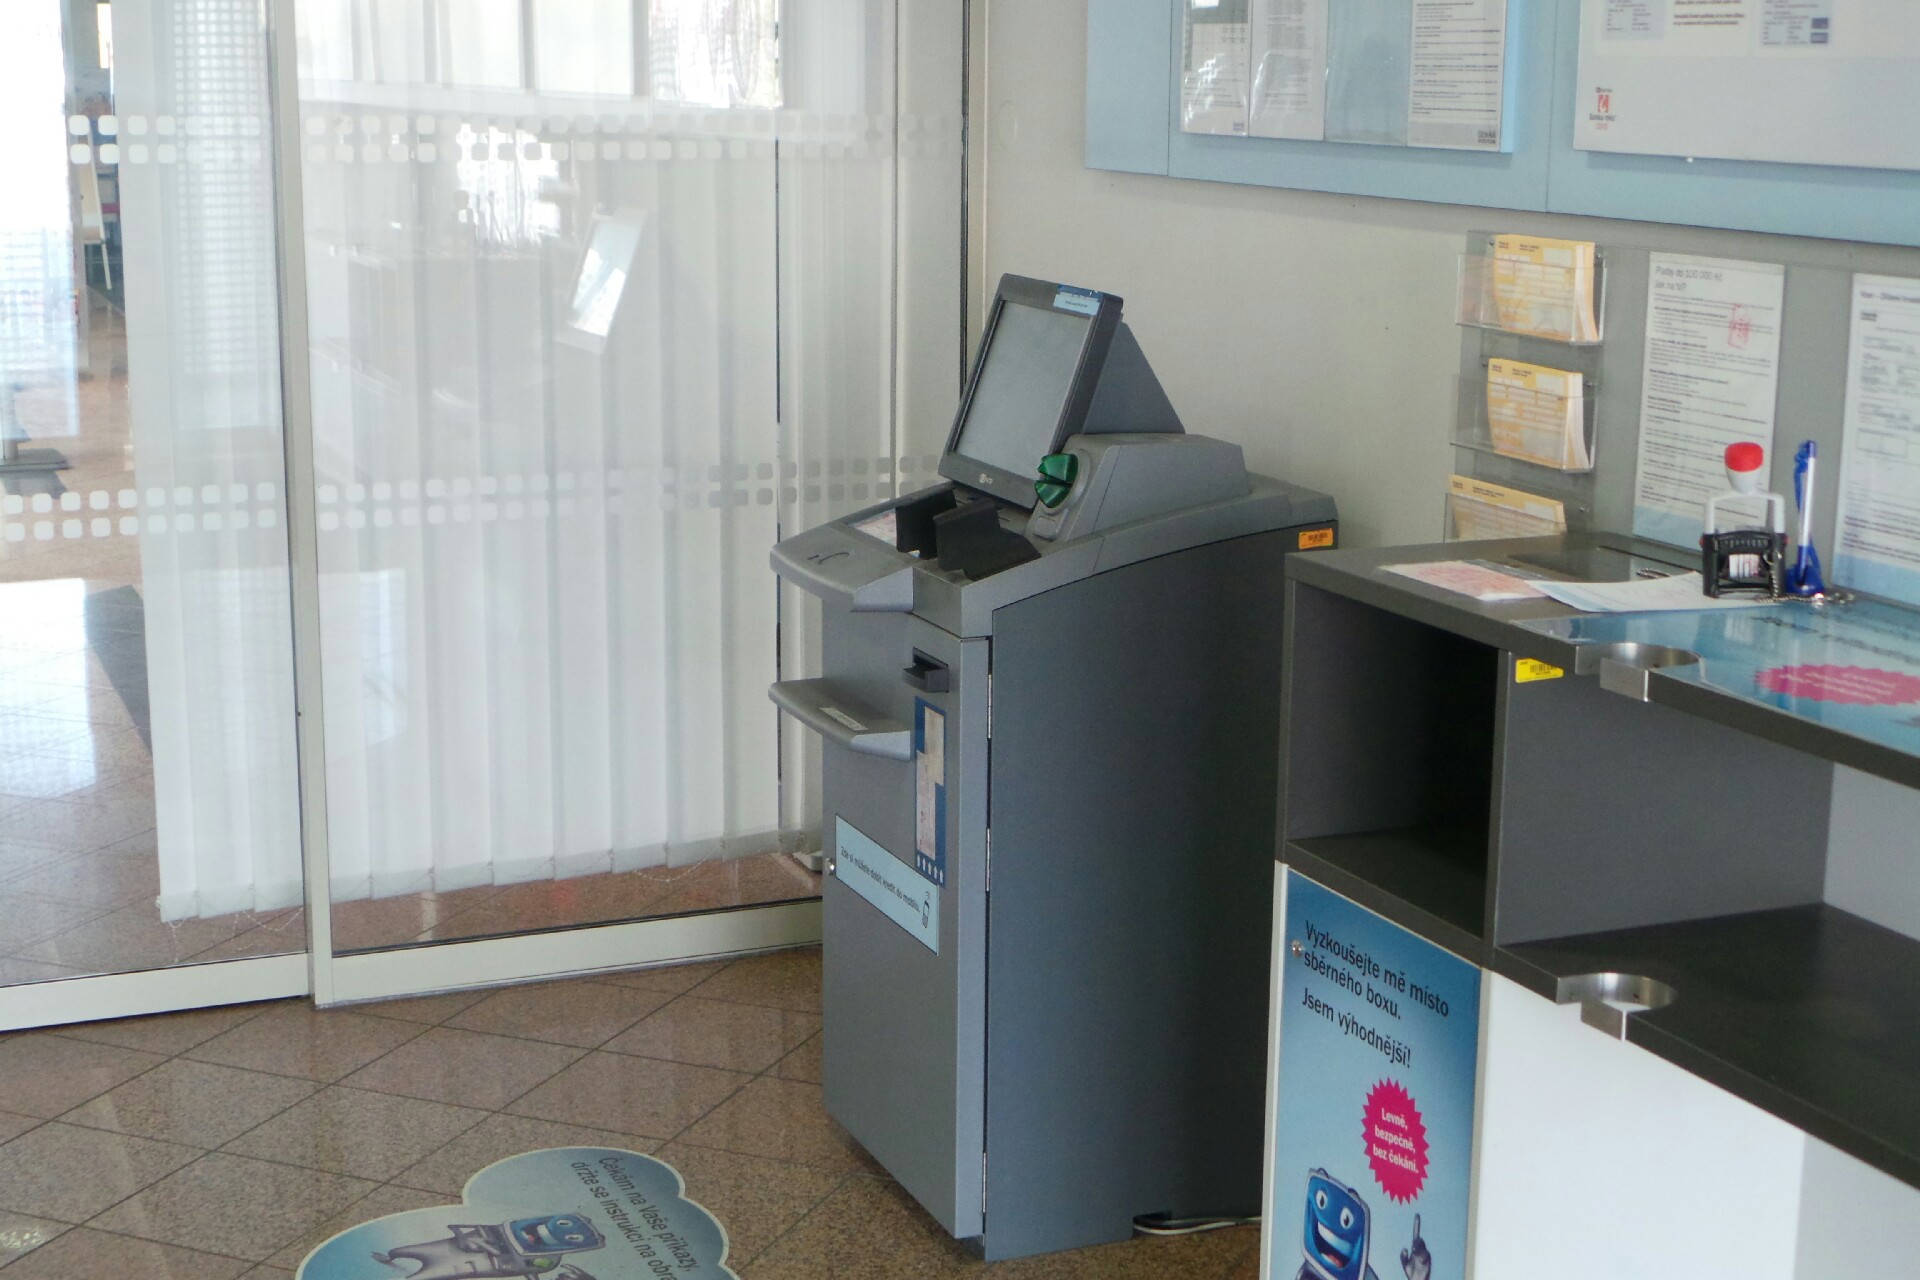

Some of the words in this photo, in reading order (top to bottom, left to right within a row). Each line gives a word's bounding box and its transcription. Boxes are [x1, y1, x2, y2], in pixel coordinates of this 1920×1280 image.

[1304, 951, 1363, 996] sběrného
[1366, 982, 1401, 1020] boxu.
[1306, 920, 1380, 978] Vyzkoušejte
[1384, 968, 1406, 993] mě
[1409, 982, 1450, 1017] místo
[1302, 987, 1335, 1022] Jsem
[1338, 1011, 1412, 1069] výhodnější!
[1374, 1124, 1417, 1154] bezpečně,
[1381, 1107, 1409, 1131] Levně,
[598, 1156, 635, 1190] Čekám
[626, 1191, 647, 1206] na
[638, 1204, 668, 1232] Vaše
[1372, 1143, 1388, 1161] bez
[1388, 1149, 1419, 1174] čekání.
[571, 1161, 599, 1186] držte
[589, 1185, 610, 1199] se
[633, 1242, 657, 1259] na
